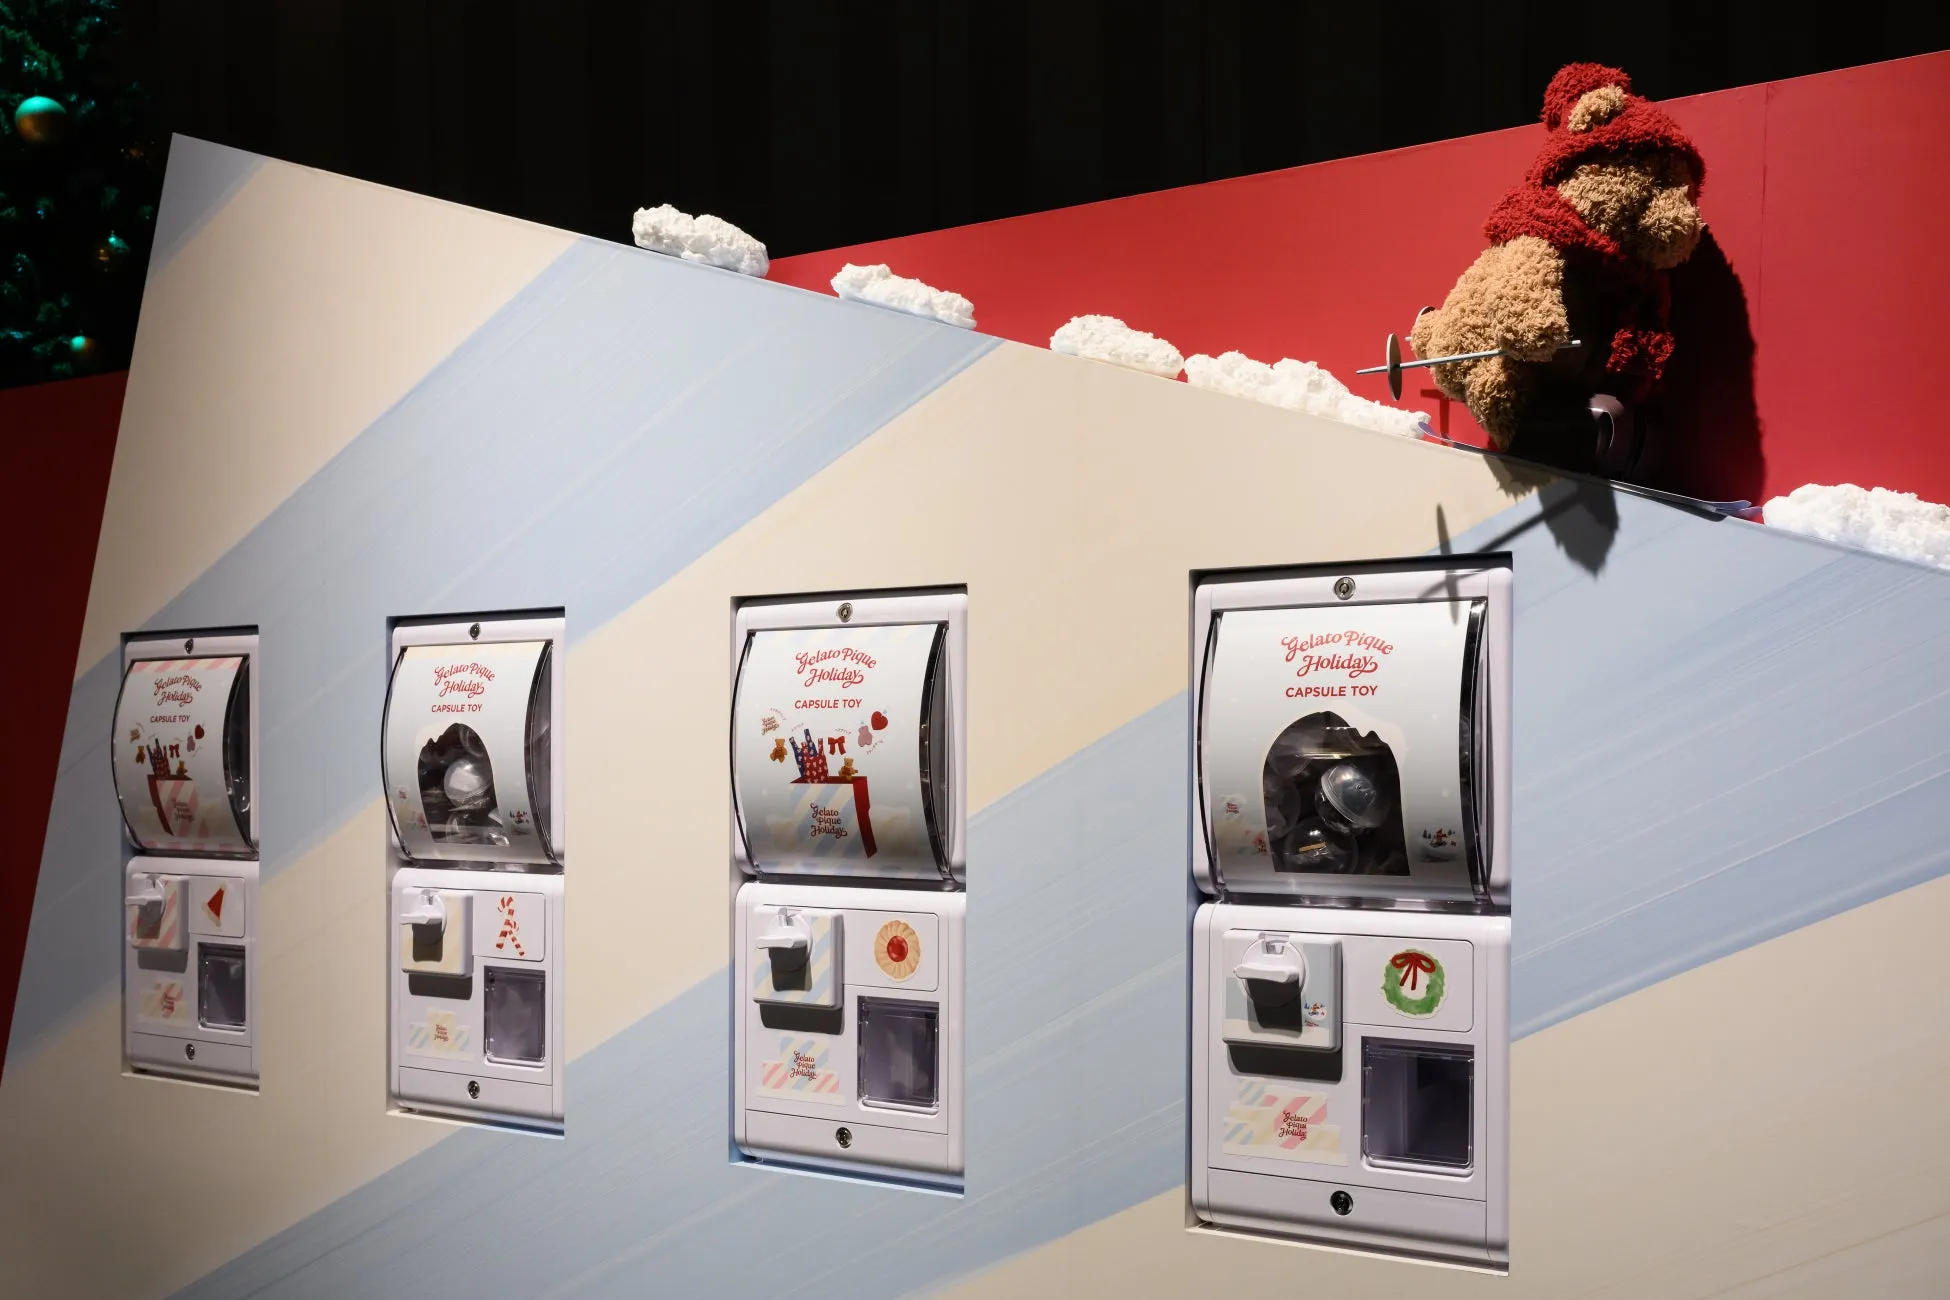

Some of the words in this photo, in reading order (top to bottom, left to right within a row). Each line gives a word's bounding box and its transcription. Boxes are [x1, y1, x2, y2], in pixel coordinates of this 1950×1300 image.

[1280, 633, 1343, 662] Gelato
[1343, 630, 1394, 655] Pique
[795, 649, 841, 675] Gelato
[841, 647, 877, 669] Pique
[1296, 653, 1379, 679] Holiday
[434, 664, 469, 686] Gelato
[469, 662, 495, 681] Pique
[804, 667, 864, 689] Holiday
[439, 679, 485, 699] Holiday
[1285, 686, 1347, 698] CAPSULE
[1350, 685, 1378, 697] TOY
[431, 704, 465, 712] CAPSULE
[467, 703, 482, 712] TOY
[794, 699, 840, 709] CAPSULE
[842, 698, 862, 709] TOY
[150, 715, 176, 723] CAPSULE
[178, 714, 190, 723] TOY
[810, 802, 839, 819] Gelato
[816, 816, 842, 826] Pique
[810, 824, 848, 840] Holiday
[1282, 1110, 1308, 1123] Gelato
